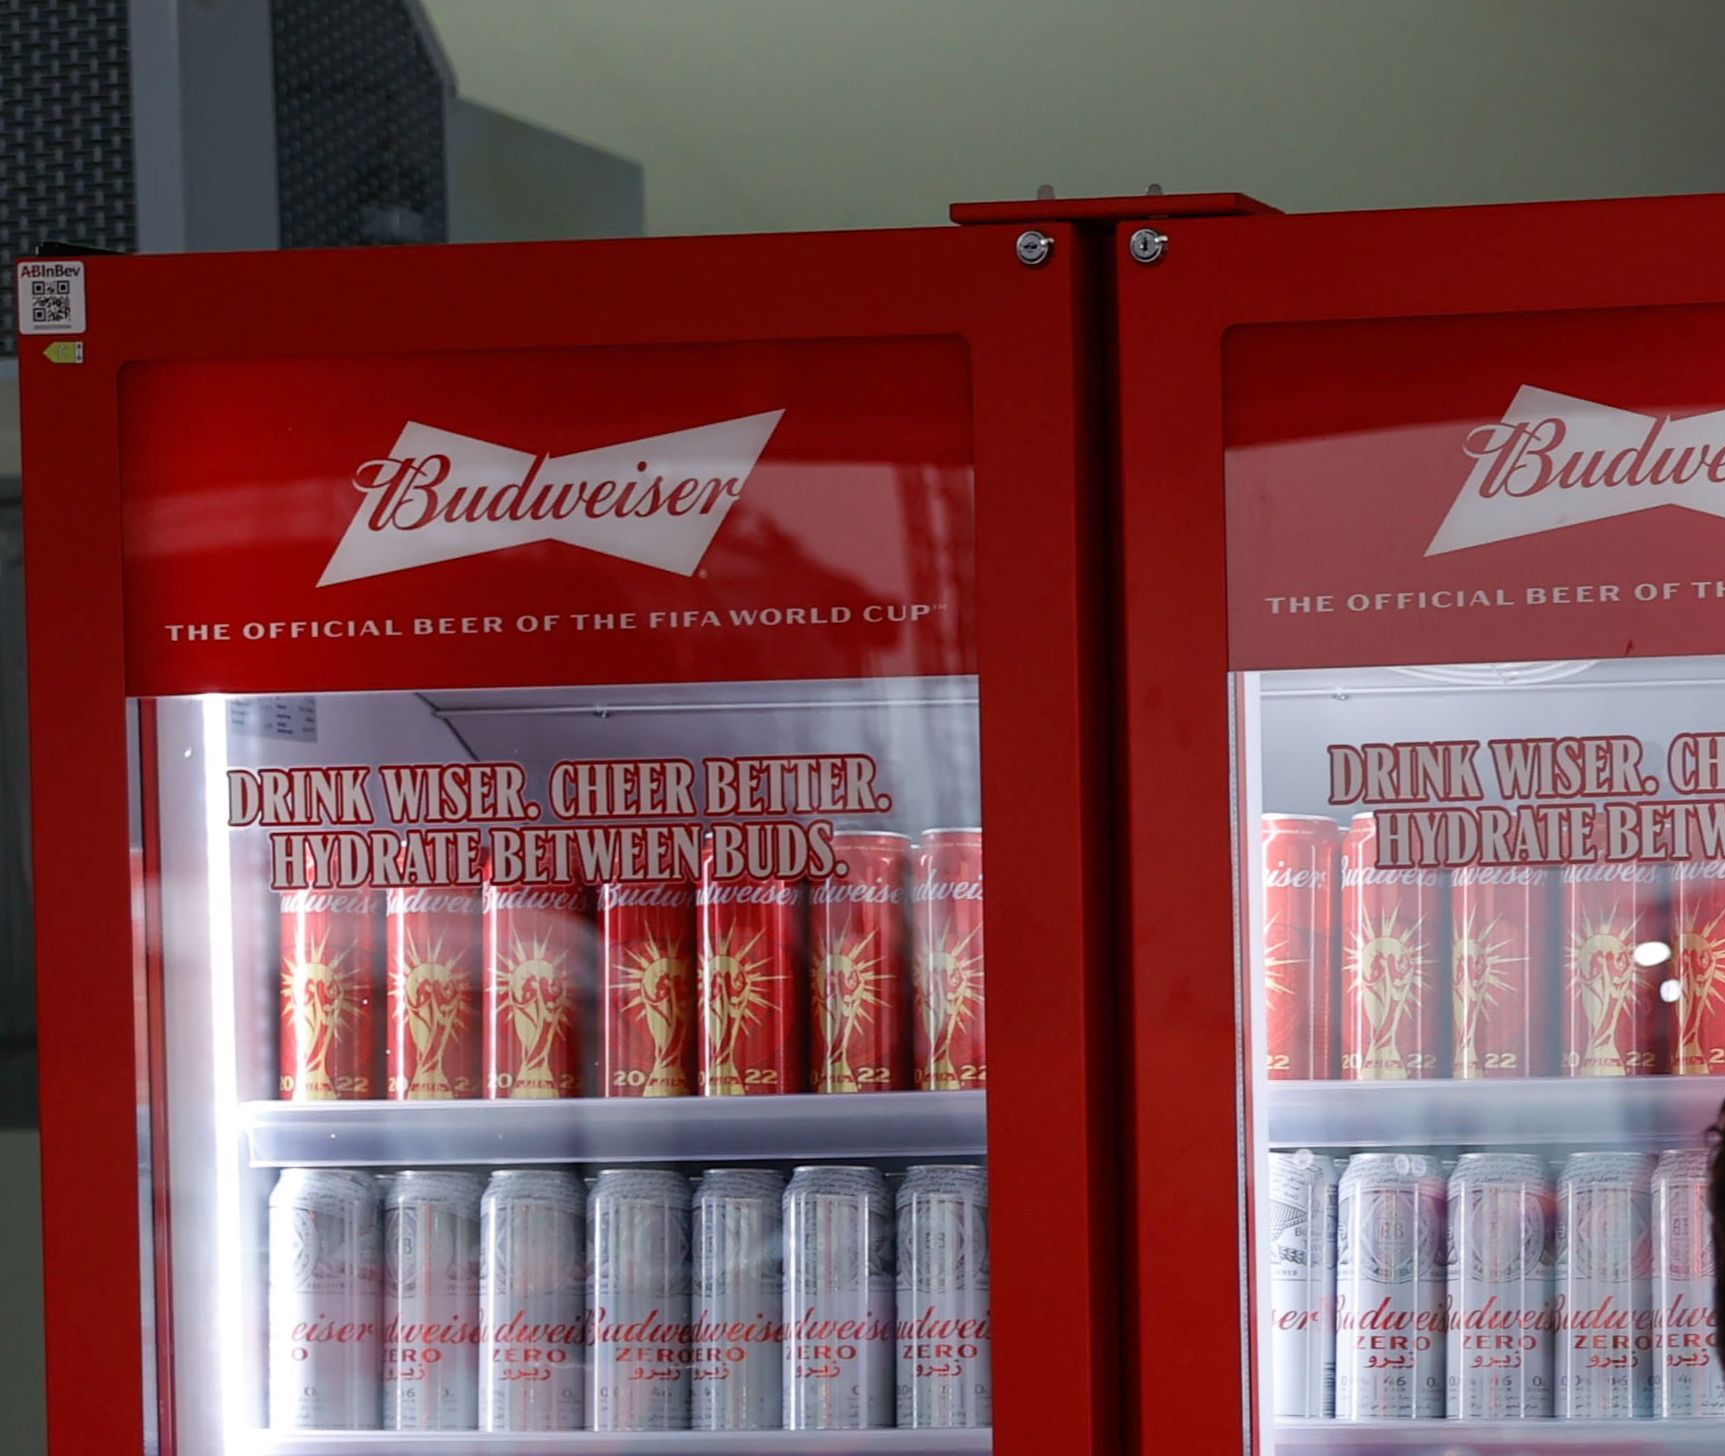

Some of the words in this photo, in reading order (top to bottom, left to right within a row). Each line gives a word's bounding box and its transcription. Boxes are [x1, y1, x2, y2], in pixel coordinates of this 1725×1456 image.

[21, 264, 80, 278] ABInBev
[352, 452, 741, 534] Budweiser
[165, 624, 231, 641] THE
[244, 620, 402, 639] OFFICIAL
[413, 616, 503, 636] BEER
[517, 614, 560, 632] OF
[571, 613, 636, 630] THE
[648, 610, 720, 628] FIFA
[730, 605, 851, 626] WORLD
[1266, 597, 1335, 615] THE
[1346, 589, 1515, 612] OFFICIAL
[1526, 584, 1620, 606] BEER
[1634, 582, 1679, 601] OF
[228, 762, 374, 827] DRINK
[379, 761, 540, 823] WISER.
[550, 758, 696, 819] CHEER
[703, 754, 892, 817] BETTER.
[1328, 741, 1480, 805] DRINK
[1487, 734, 1659, 800] WISER.
[270, 828, 482, 891] HYDRATE
[482, 823, 702, 886] BETWEEN
[716, 819, 850, 880] BUDS.
[1374, 805, 1598, 871] HYDRATE
